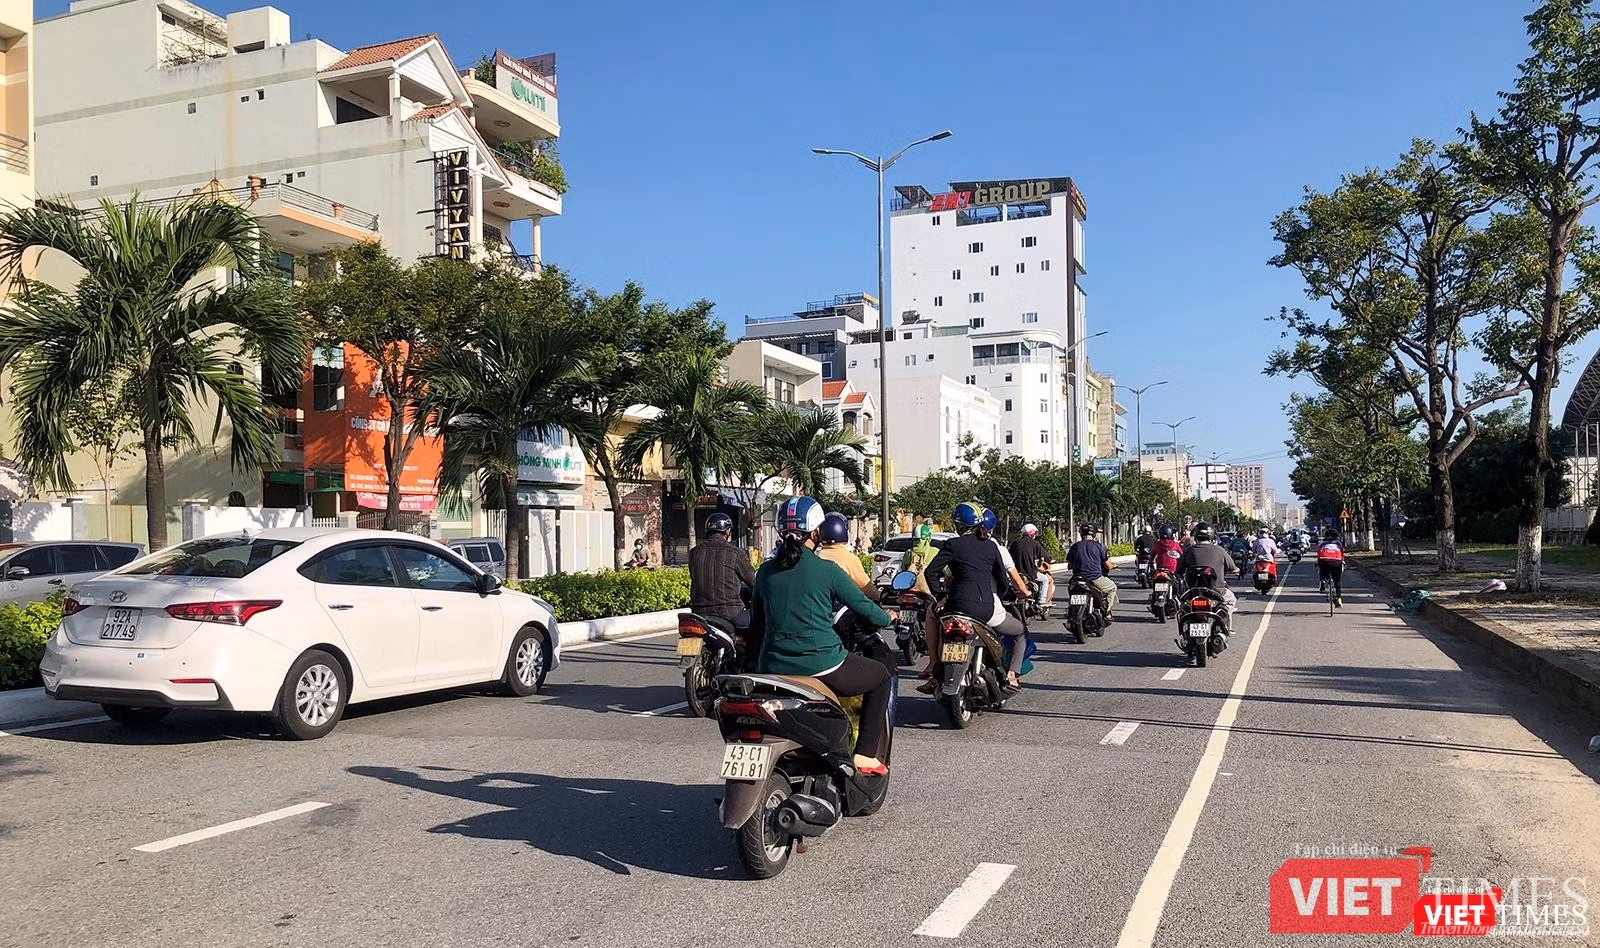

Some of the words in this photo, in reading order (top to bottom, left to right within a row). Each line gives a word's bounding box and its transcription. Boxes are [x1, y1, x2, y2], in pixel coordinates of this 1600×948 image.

[974, 181, 1050, 206] GROUP
[450, 151, 464, 259] VIVYAN
[517, 451, 542, 468] HÔNG
[113, 610, 132, 624] 92A
[103, 623, 136, 638] 217.49
[722, 761, 763, 778] 761.81
